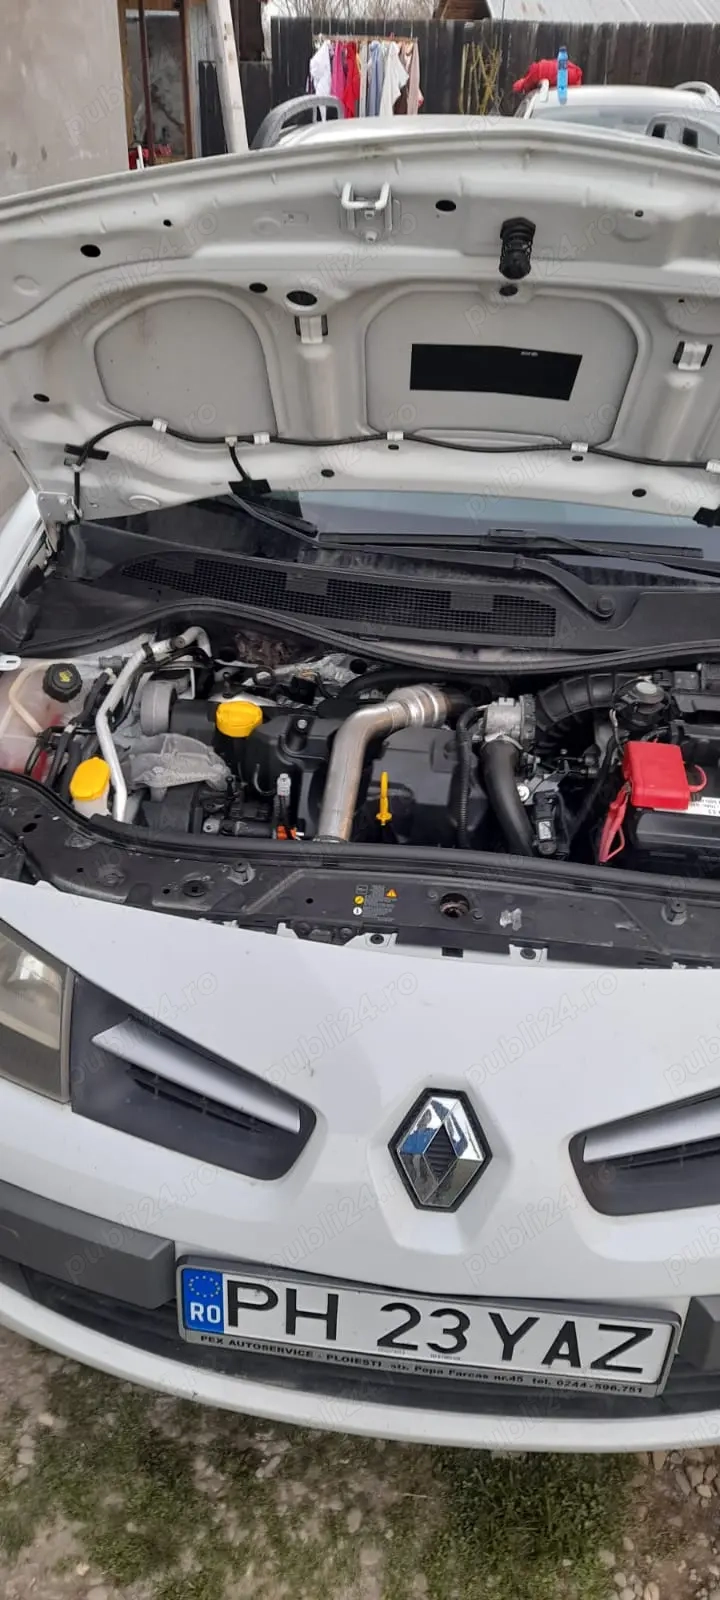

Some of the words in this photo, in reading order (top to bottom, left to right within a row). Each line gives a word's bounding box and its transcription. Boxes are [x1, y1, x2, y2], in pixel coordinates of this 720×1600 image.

[190, 1301, 221, 1324] RO
[226, 1279, 339, 1341] PH
[376, 1302, 470, 1354] 23
[488, 1311, 653, 1374] YAZ
[200, 1335, 224, 1345] PEX
[228, 1339, 314, 1357] AUTOSERVICE
[325, 1353, 382, 1367] PLOIESTI
